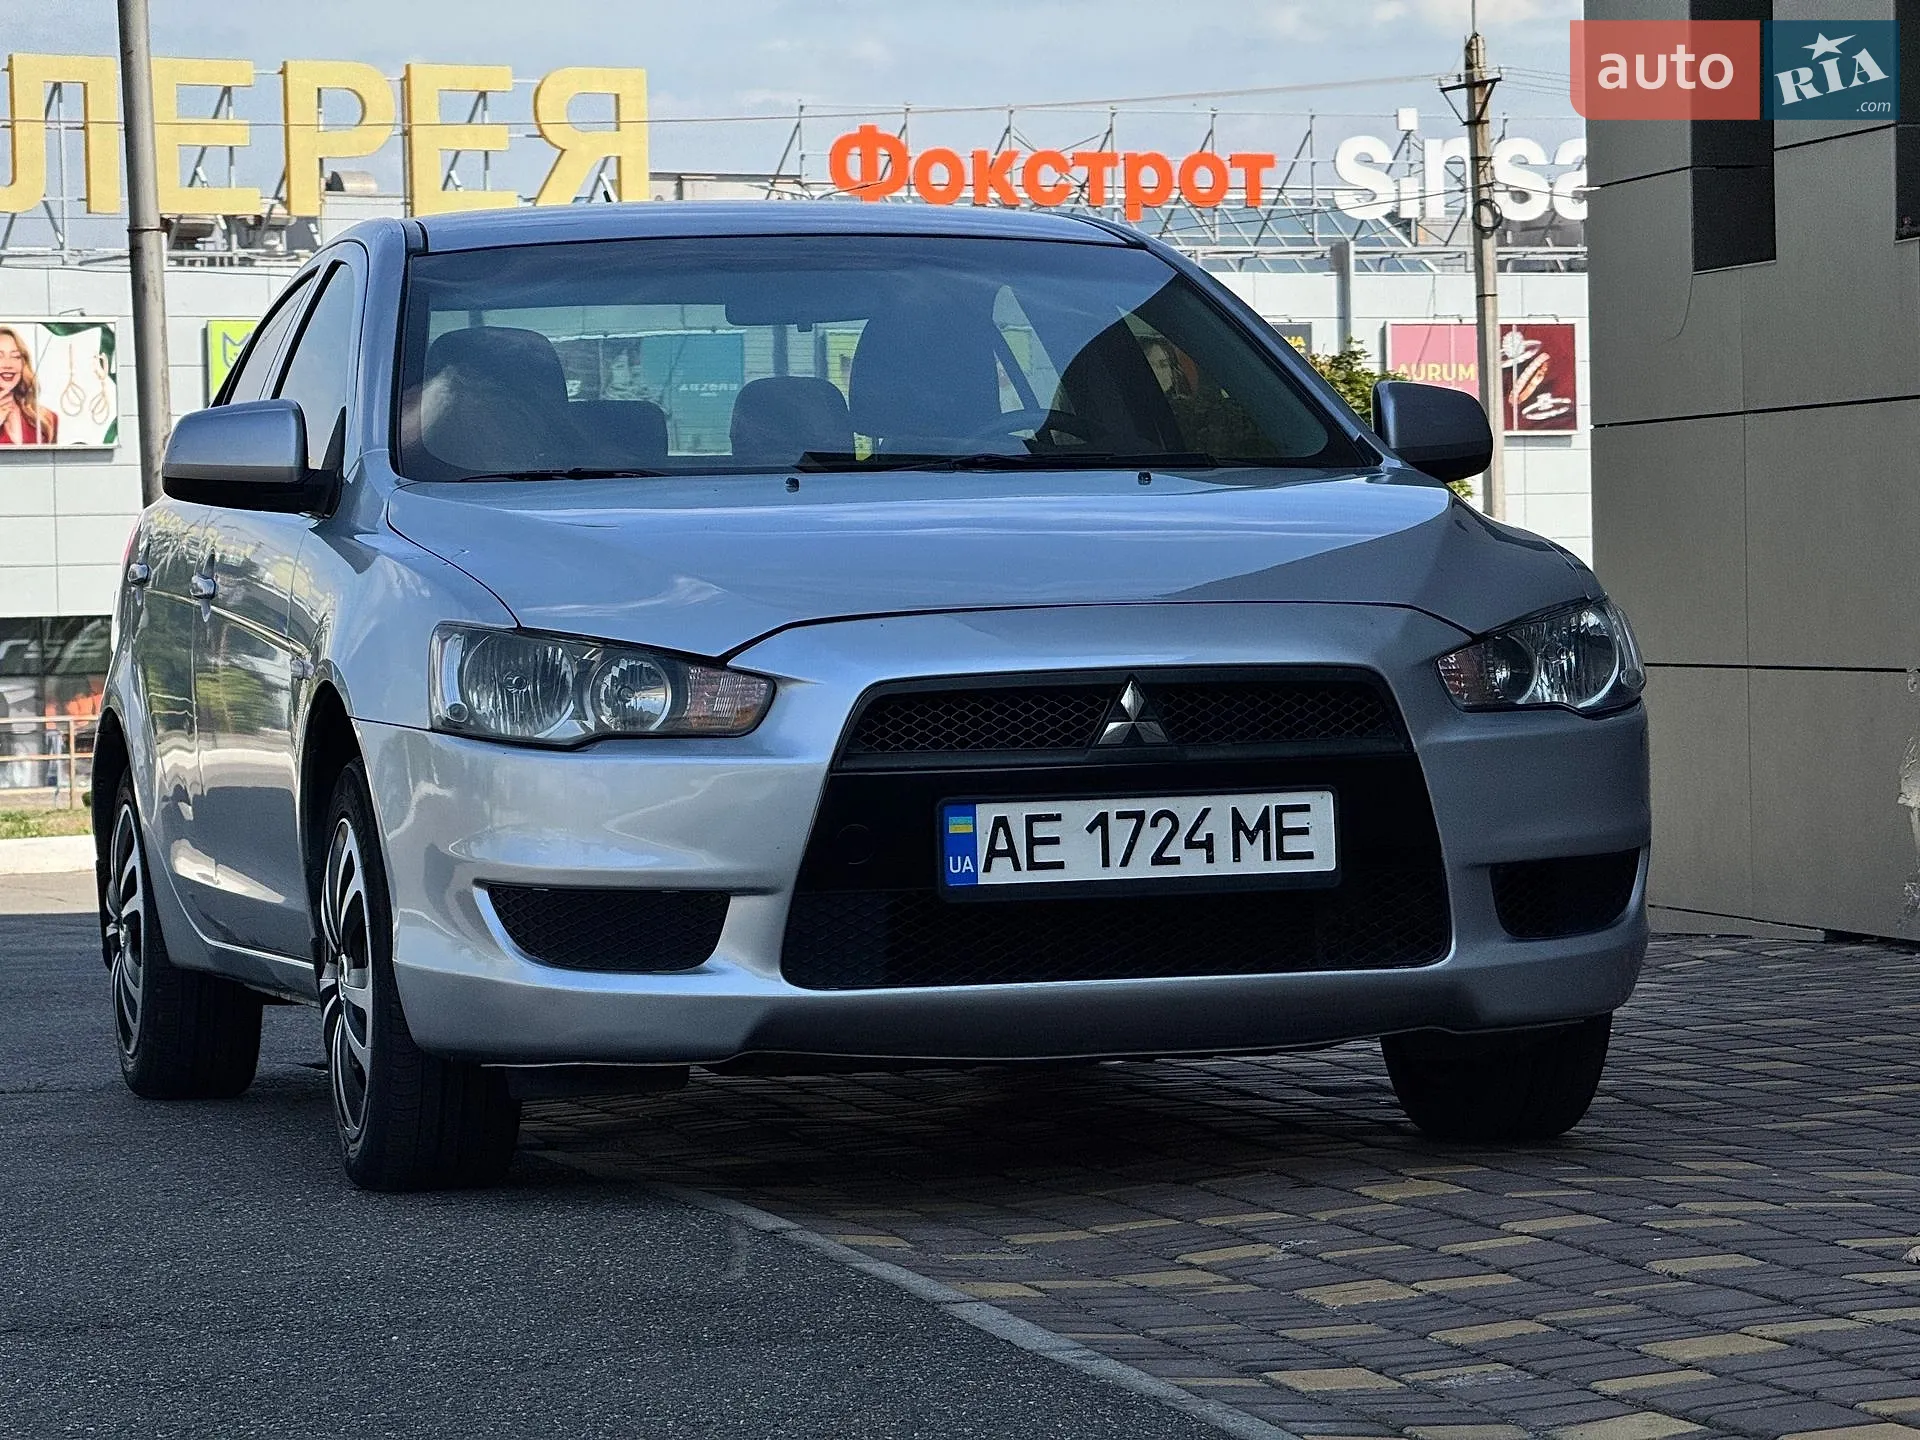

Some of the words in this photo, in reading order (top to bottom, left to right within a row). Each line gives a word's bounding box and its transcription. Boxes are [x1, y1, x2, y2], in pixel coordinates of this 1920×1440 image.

[0, 52, 649, 216] ЛЕРЕЯ
[829, 124, 1275, 221] Фокстрот
[1398, 363, 1476, 382] AURUM
[950, 856, 974, 873] UA
[982, 813, 1065, 873] AE
[1085, 807, 1215, 868] 1724
[1231, 804, 1314, 863] ME
